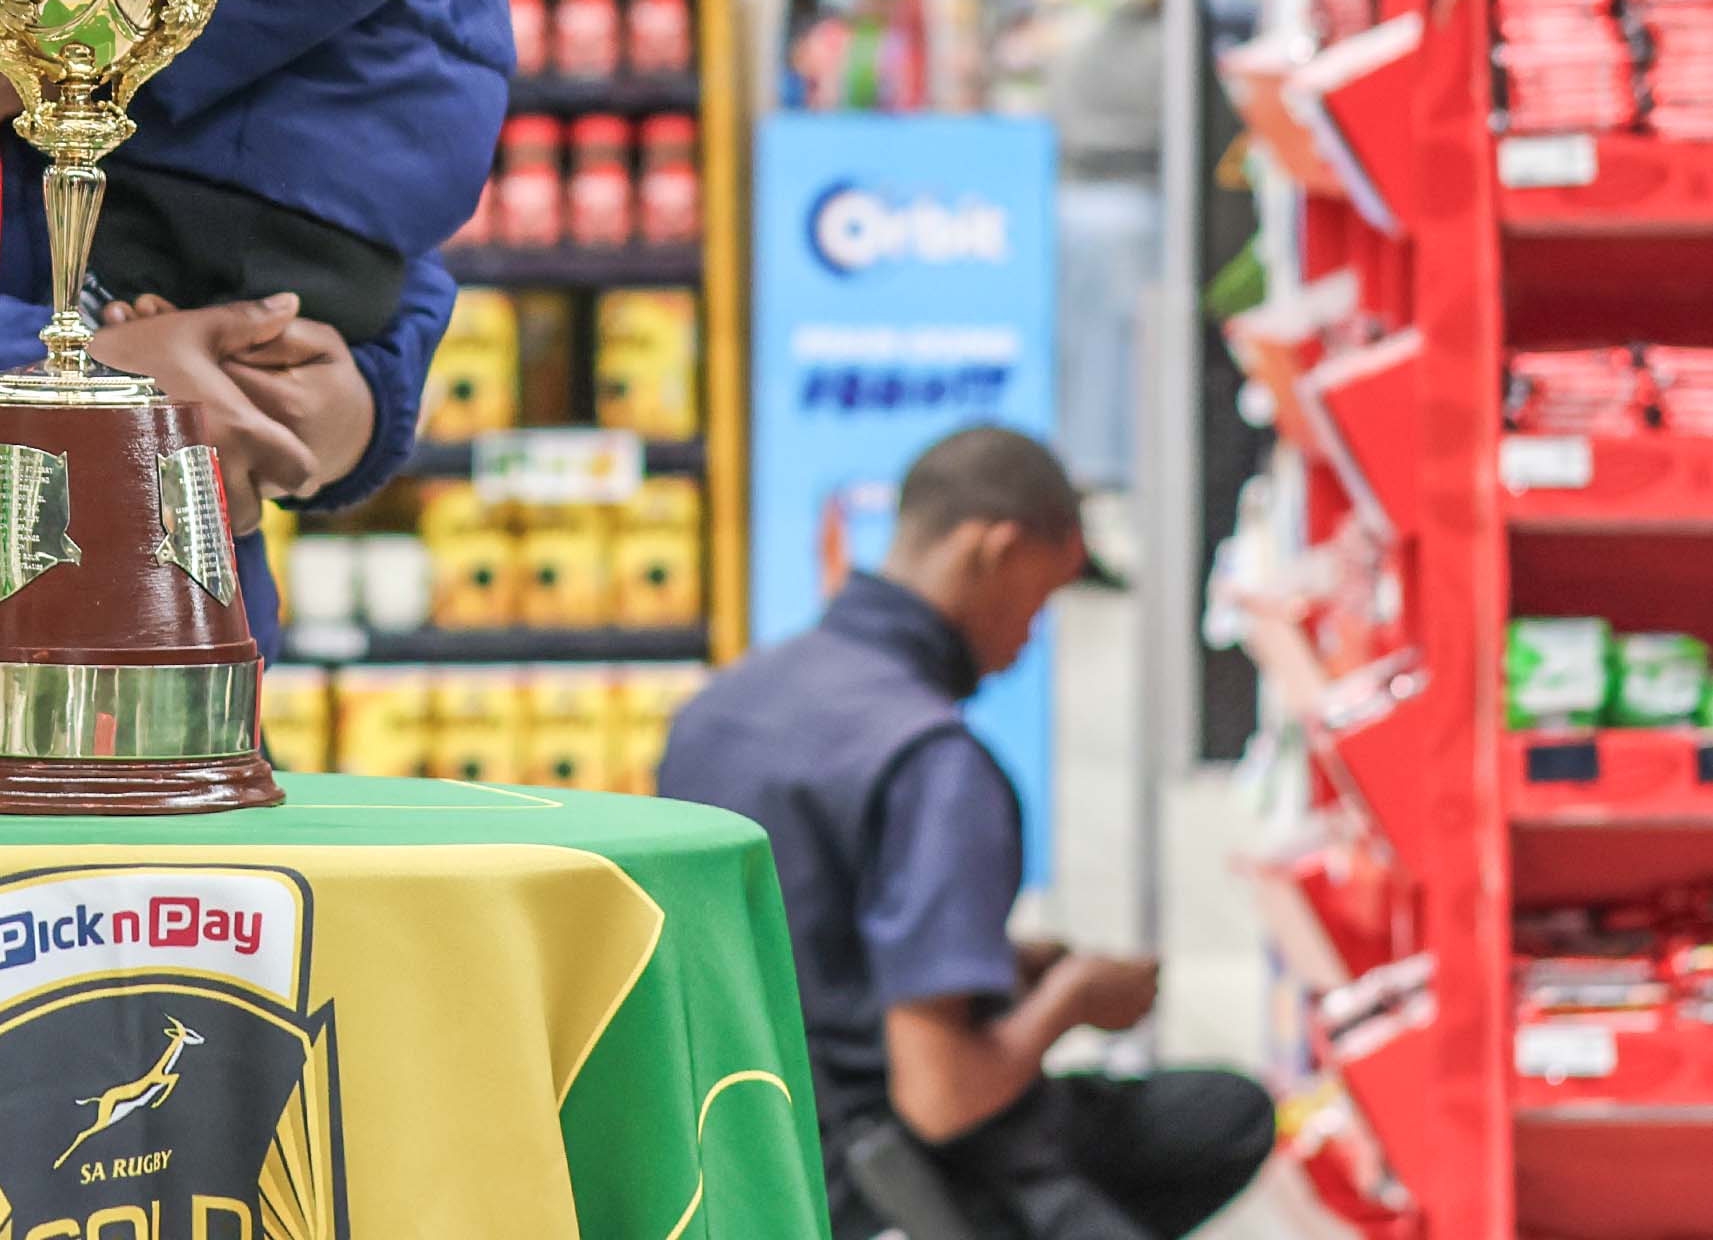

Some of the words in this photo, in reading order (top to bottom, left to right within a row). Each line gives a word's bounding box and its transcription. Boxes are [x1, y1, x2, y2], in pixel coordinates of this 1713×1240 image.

[112, 910, 140, 944] n
[150, 896, 262, 955] Pay
[80, 1162, 106, 1185] SA
[112, 1149, 173, 1179] RUGBY
